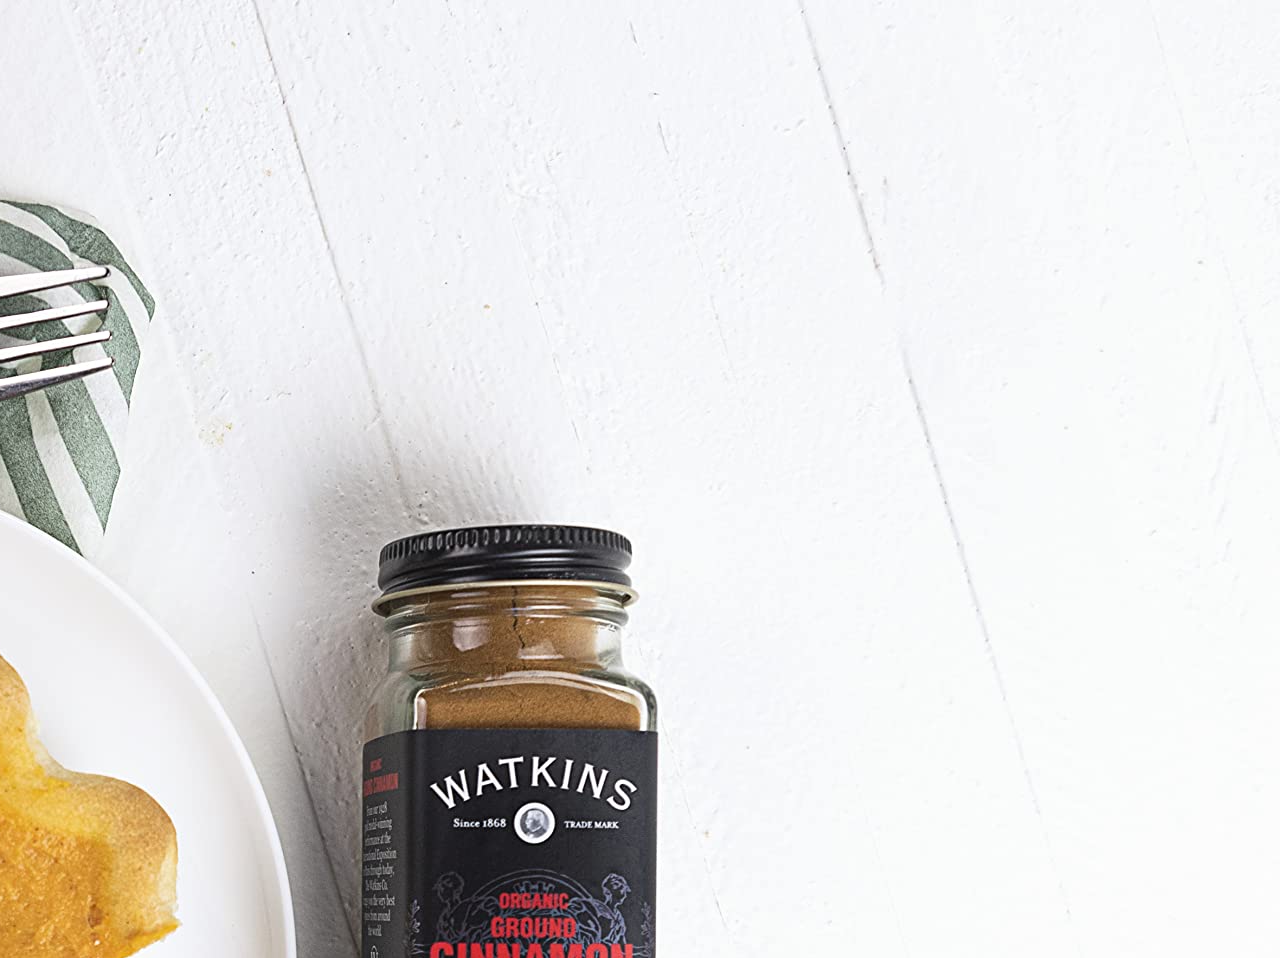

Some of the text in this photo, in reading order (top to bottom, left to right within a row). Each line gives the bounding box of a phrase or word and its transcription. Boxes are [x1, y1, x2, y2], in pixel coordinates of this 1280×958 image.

[430, 756, 637, 811] WATKINS
[453, 818, 507, 828] Since 1868
[564, 821, 619, 829] TRADE MARK
[499, 892, 569, 910] ORGANIC
[490, 916, 576, 938] GROUND
